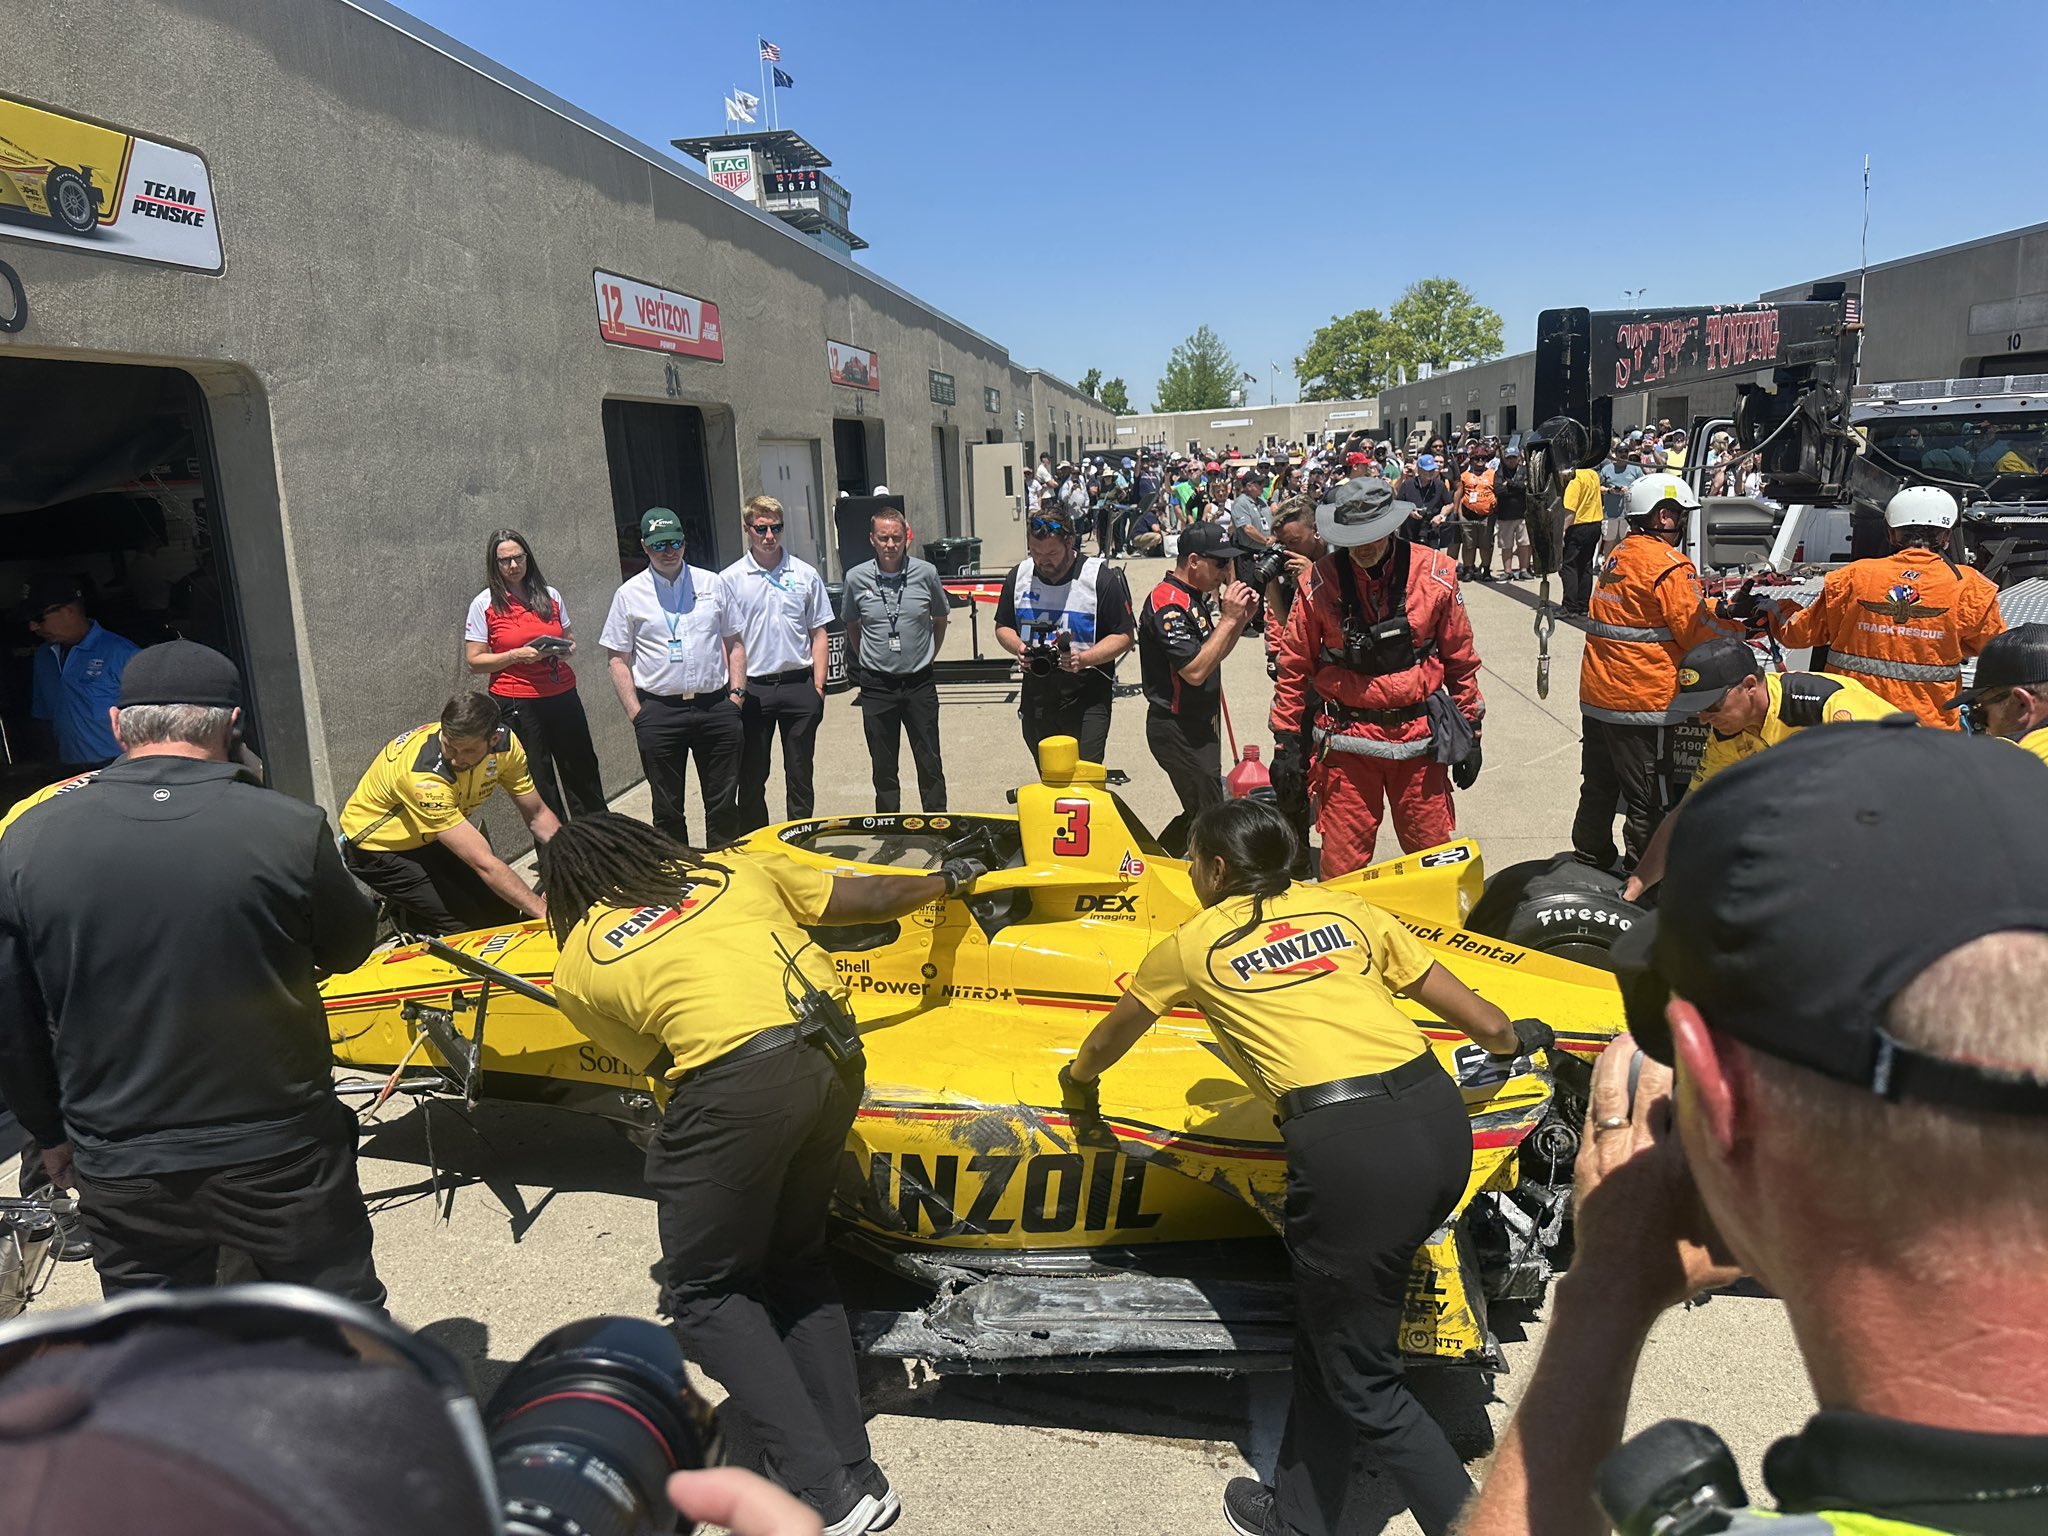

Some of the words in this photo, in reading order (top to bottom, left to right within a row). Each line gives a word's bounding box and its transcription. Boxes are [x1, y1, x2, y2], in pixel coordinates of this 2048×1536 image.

[714, 158, 746, 172] TAG
[714, 171, 748, 190] HEUER
[144, 180, 196, 205] TEAM
[132, 199, 204, 227] PENSKE
[601, 283, 626, 335] 12
[635, 293, 691, 335] verizon
[1705, 310, 1780, 370] TOWING
[2007, 333, 2021, 350] 10
[1941, 516, 1951, 526] 55
[1856, 621, 1894, 636] TRACK
[1897, 626, 1945, 640] RESCUE
[828, 636, 845, 651] EEP
[829, 651, 845, 666] DY
[827, 663, 848, 680] LEA
[877, 818, 895, 826] NTT
[1053, 797, 1091, 857] 3
[1130, 861, 1141, 875] E
[1074, 895, 1140, 913] DEX
[1090, 913, 1137, 922] imaging
[1537, 908, 1632, 932] Firesto
[1392, 914, 1445, 942] uck
[1446, 933, 1526, 965] Rental
[1230, 923, 1353, 982] PENNZOIL
[836, 959, 870, 973] Shell
[838, 975, 930, 996] V-Power
[843, 1152, 1163, 1237] NNZOIL
[1433, 1338, 1463, 1350] NTT
